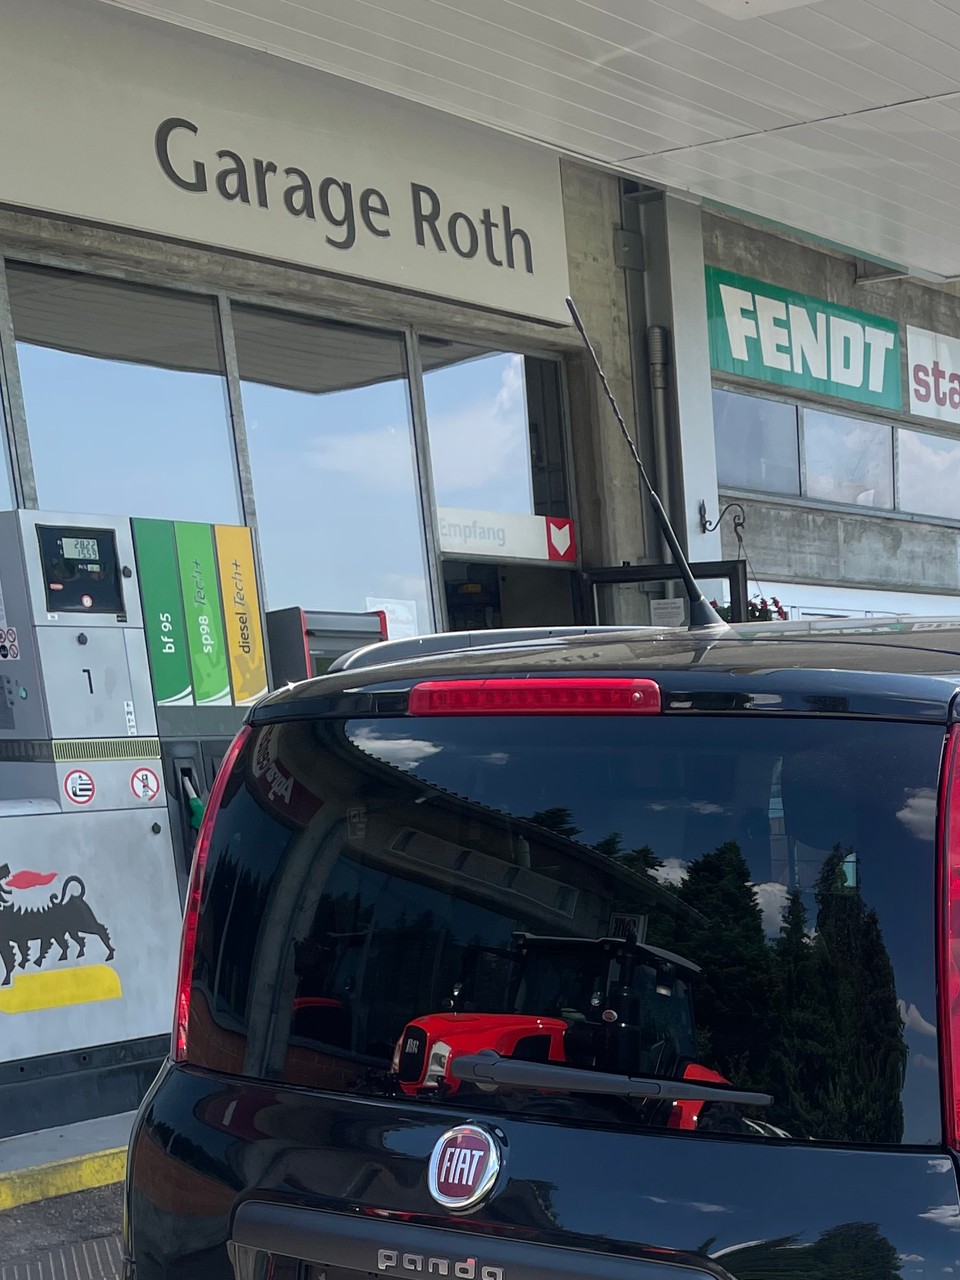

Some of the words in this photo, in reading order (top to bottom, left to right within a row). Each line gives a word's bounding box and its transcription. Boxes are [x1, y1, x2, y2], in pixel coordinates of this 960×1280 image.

[154, 116, 391, 250] Garage
[410, 181, 534, 275] Roth
[719, 283, 895, 394] FENDT
[439, 518, 506, 547] Empfang
[231, 559, 246, 607] Tech+
[159, 612, 173, 632] 95
[198, 615, 215, 654] sp98
[234, 611, 251, 654] diesel
[160, 635, 175, 653] bf
[440, 1147, 485, 1186] FIAT
